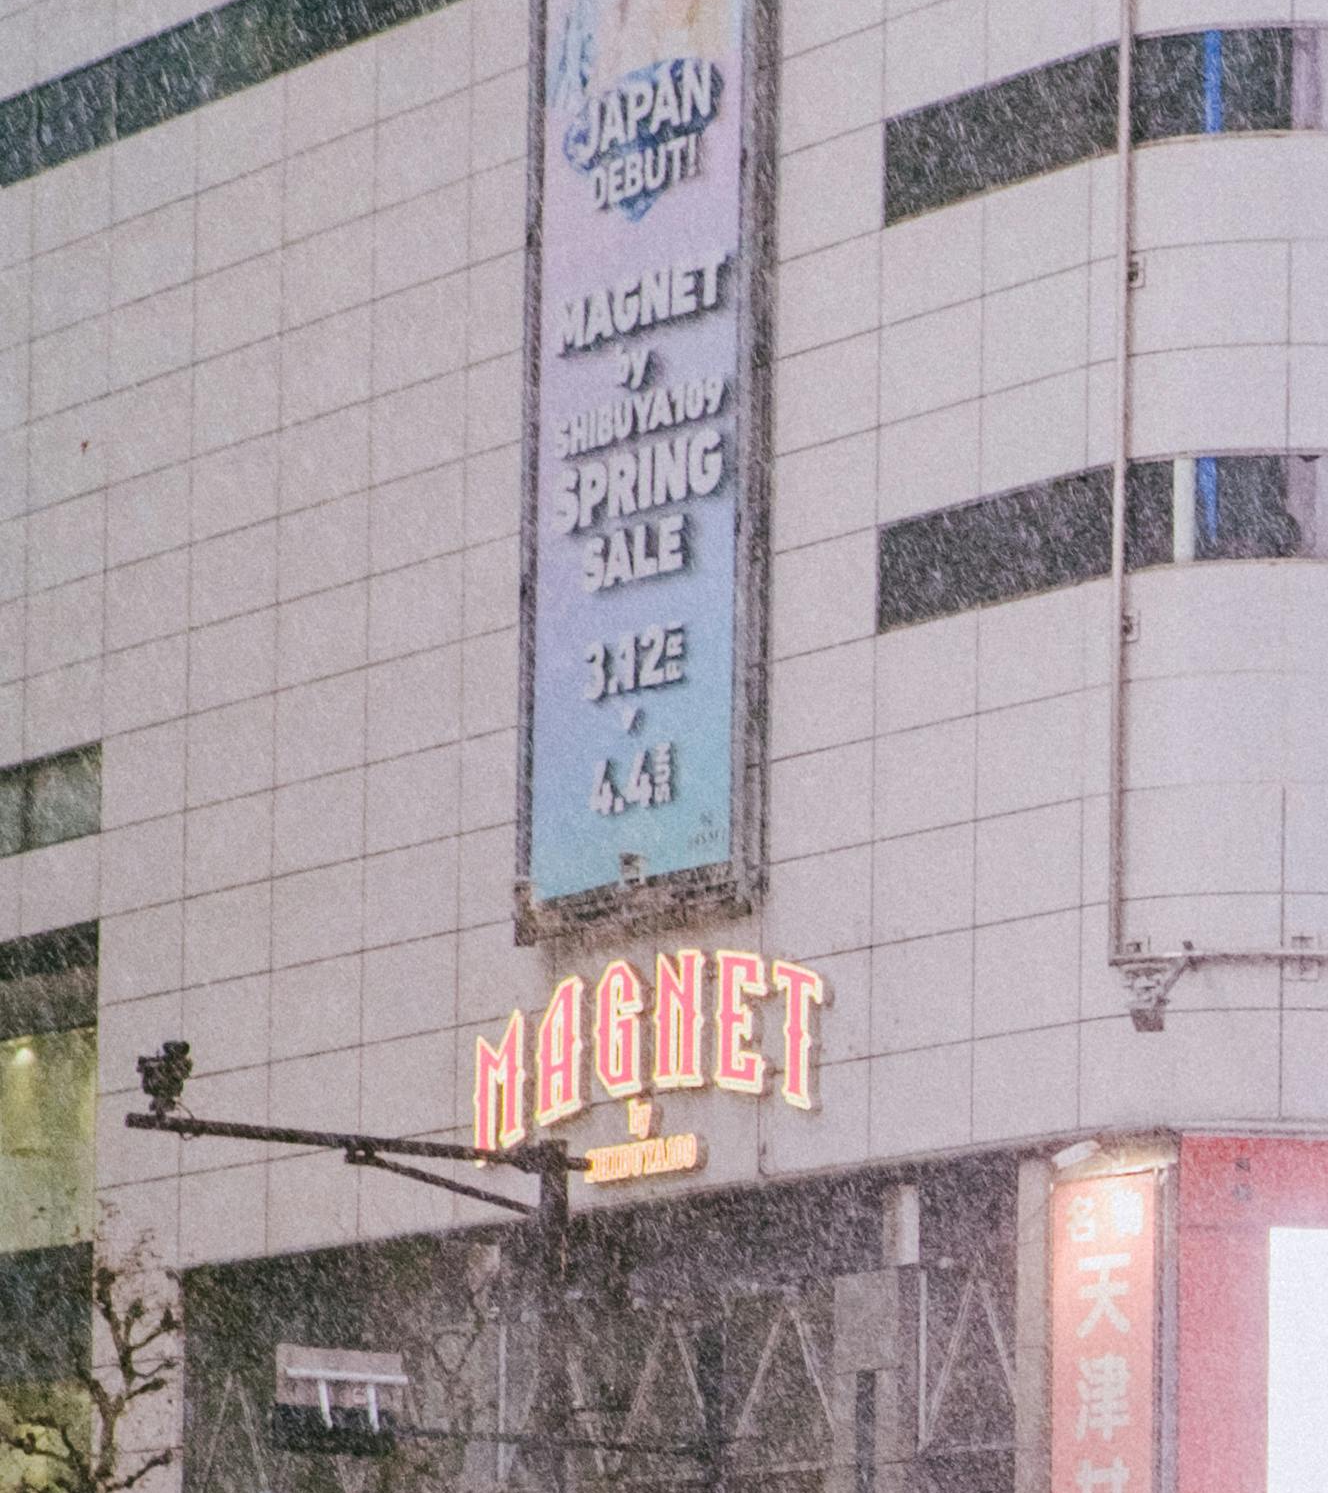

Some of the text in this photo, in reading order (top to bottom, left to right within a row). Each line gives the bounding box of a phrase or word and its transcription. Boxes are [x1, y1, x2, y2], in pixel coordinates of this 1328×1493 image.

[573, 57, 713, 163] JAPAN
[591, 133, 698, 209] DEBUT!
[556, 251, 728, 352] MAGNET
[556, 376, 726, 457] SHIBUYA109
[550, 427, 723, 534] SPRING
[583, 514, 684, 593] SALE
[584, 623, 665, 700] 3.12
[590, 749, 653, 815] 4.4
[473, 949, 824, 1168] MAGNET
